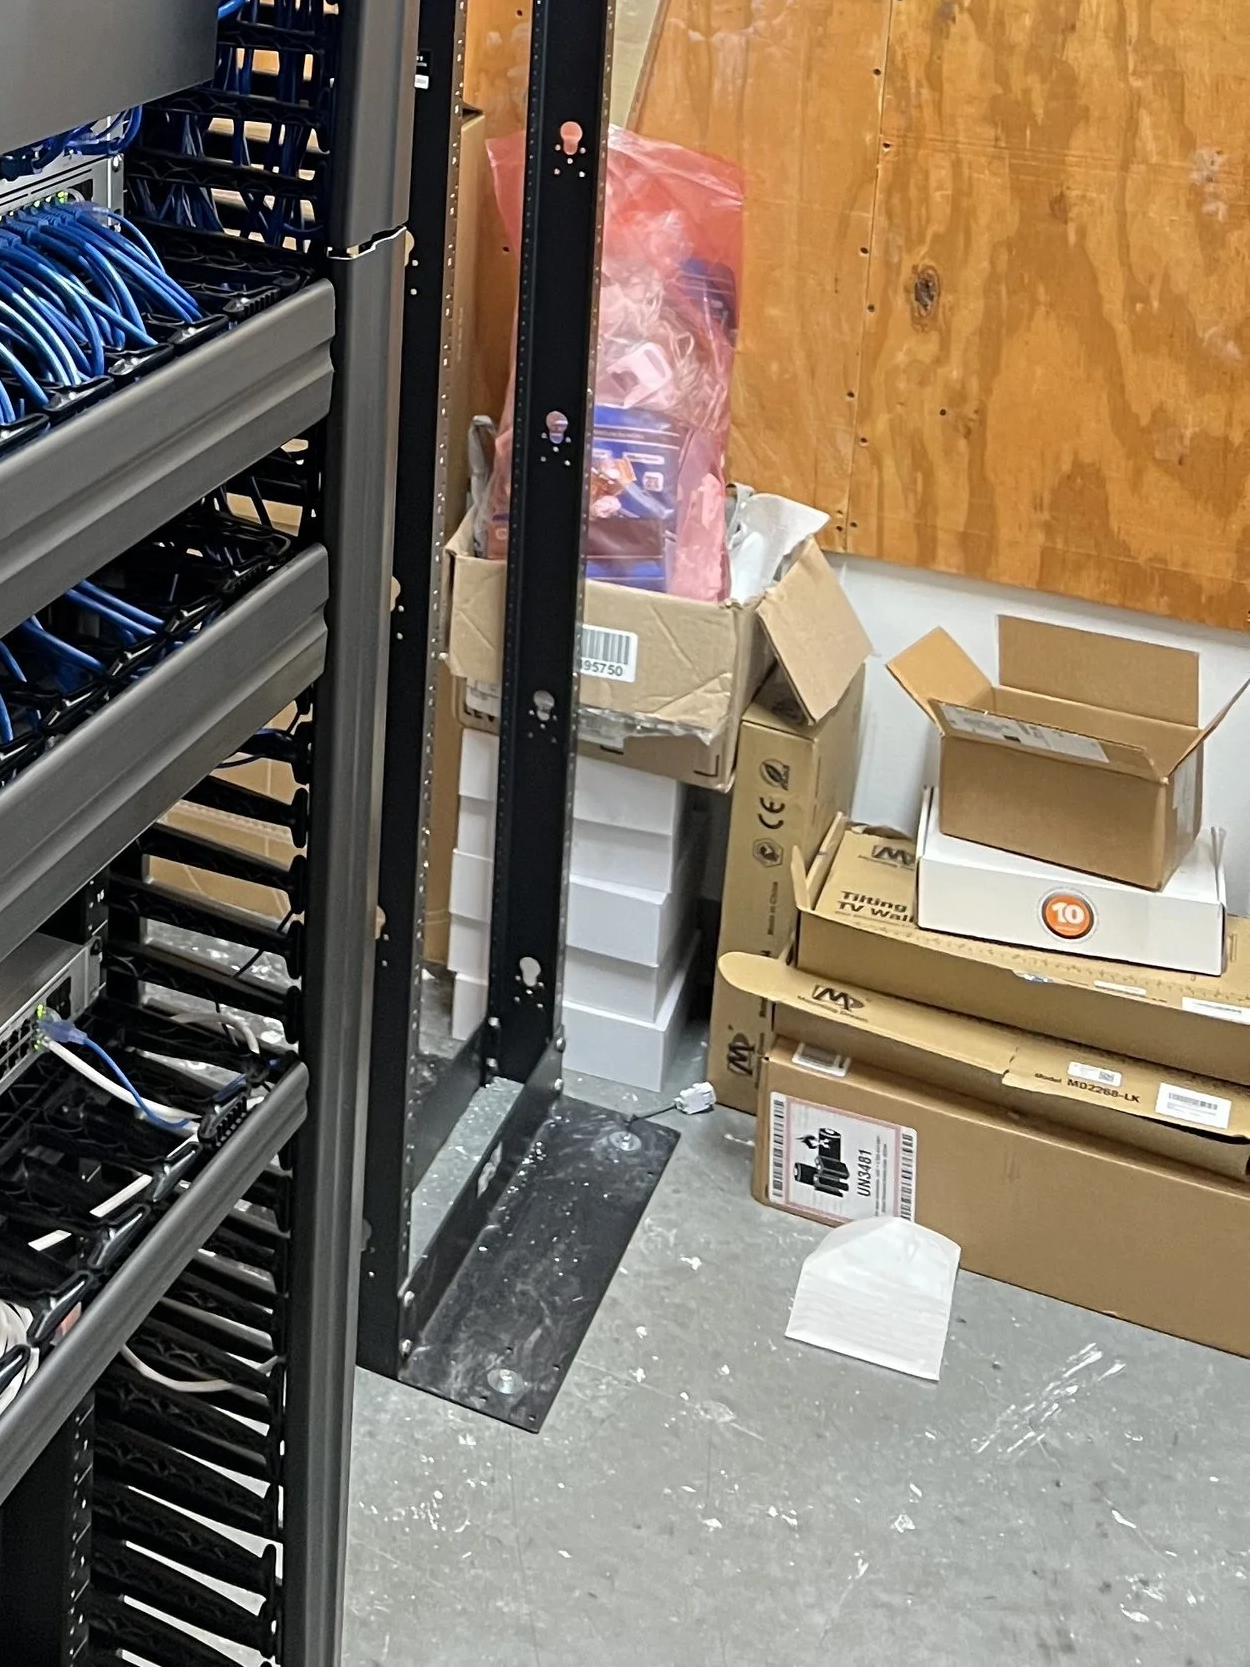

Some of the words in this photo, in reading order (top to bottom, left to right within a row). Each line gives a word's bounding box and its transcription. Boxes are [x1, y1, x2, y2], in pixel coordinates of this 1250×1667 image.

[837, 900, 865, 912] TV
[870, 907, 914, 923] Wall
[840, 890, 907, 913] Tilting
[1051, 901, 1085, 925] 10
[1067, 1078, 1140, 1104] MD2268-LK
[857, 1148, 873, 1197] UN3481
